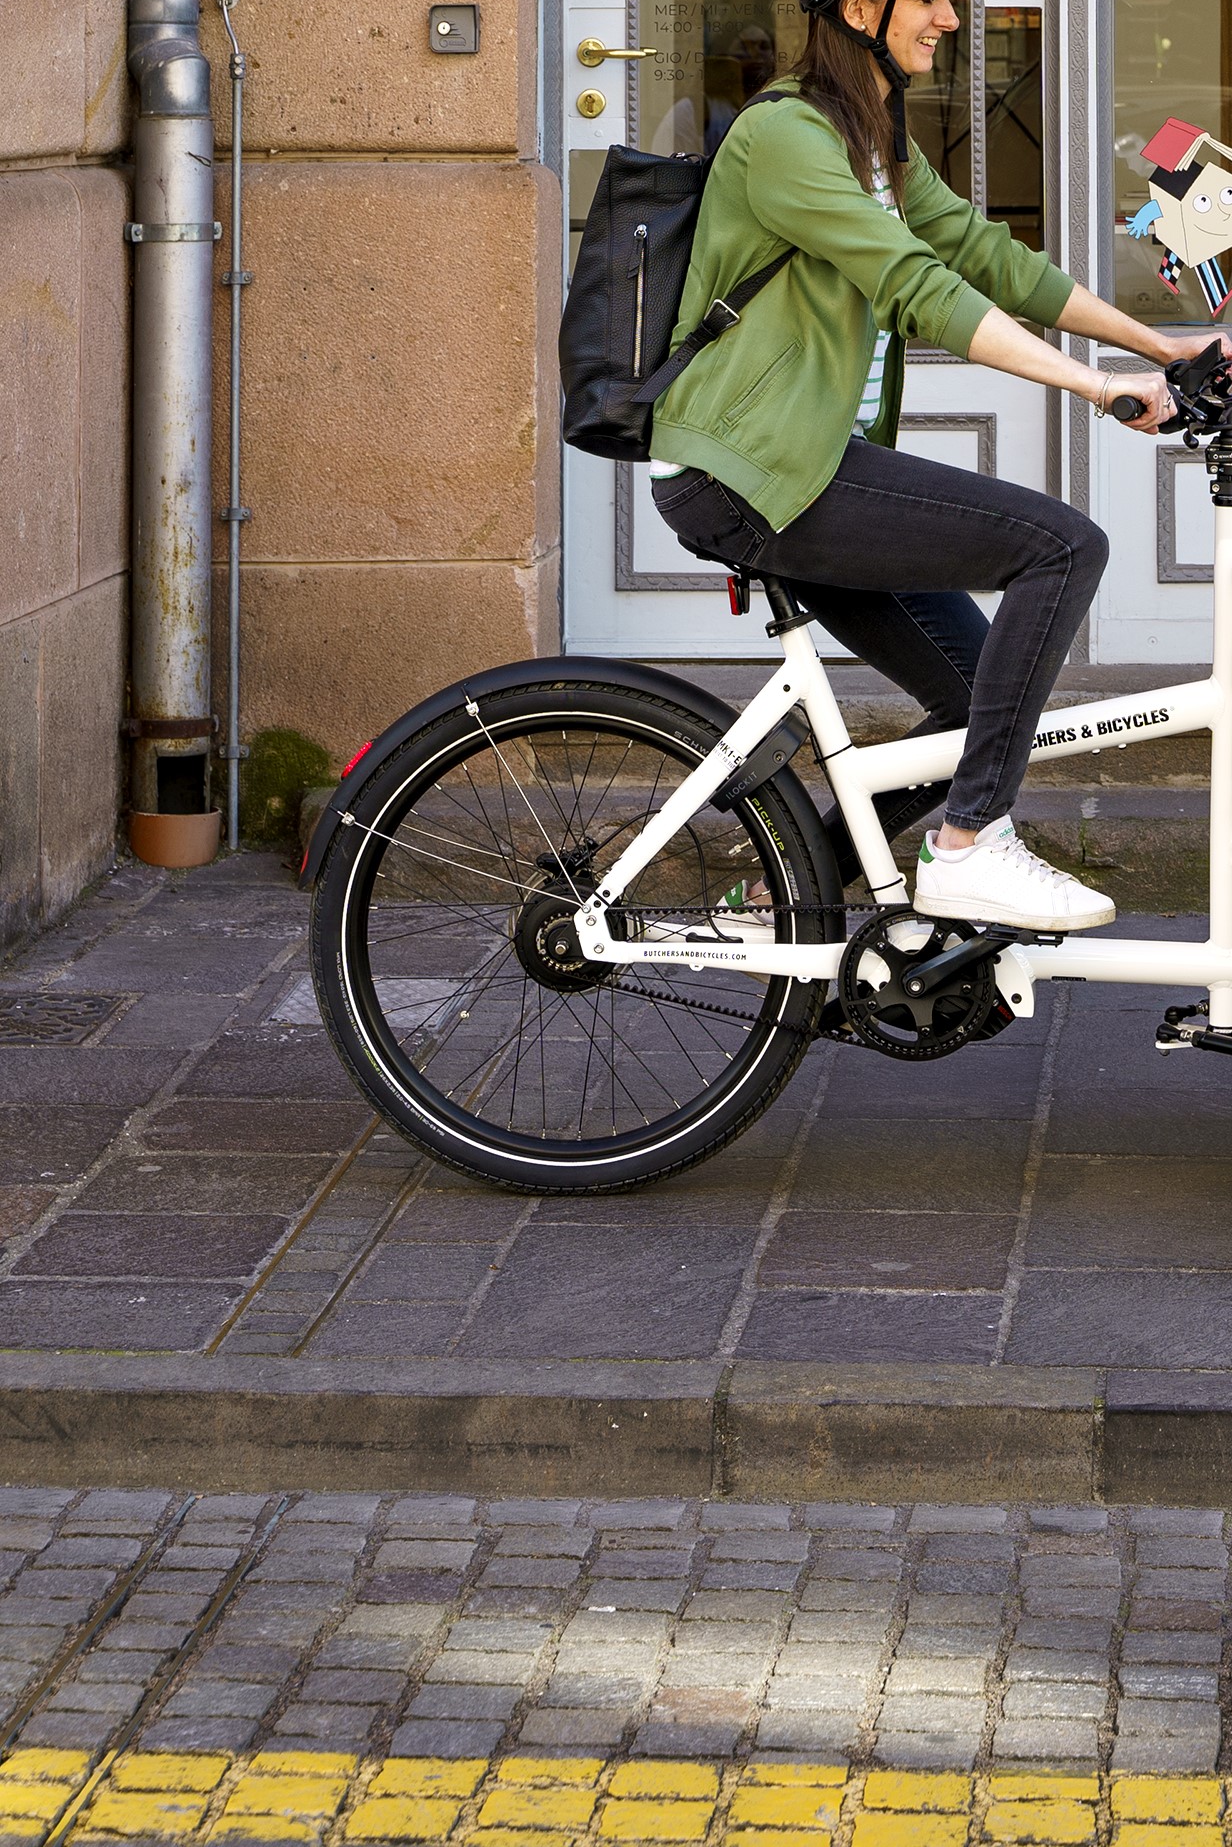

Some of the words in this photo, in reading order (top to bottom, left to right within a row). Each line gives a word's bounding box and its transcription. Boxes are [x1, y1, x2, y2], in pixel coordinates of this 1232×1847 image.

[655, 4, 688, 16] MER
[701, 4, 717, 16] MI
[777, 4, 796, 16] FR
[654, 22, 692, 33] 14:00
[706, 22, 744, 33] 18:00
[654, 52, 682, 64] GIO
[654, 69, 685, 81] 9:30
[1031, 727, 1077, 749] CHERS
[1096, 708, 1170, 735] BICYCLES
[674, 731, 710, 755] SCHW
[752, 797, 785, 851] PICK-UP
[643, 950, 747, 960] BUTCHERSANDBICYCLES.COM
